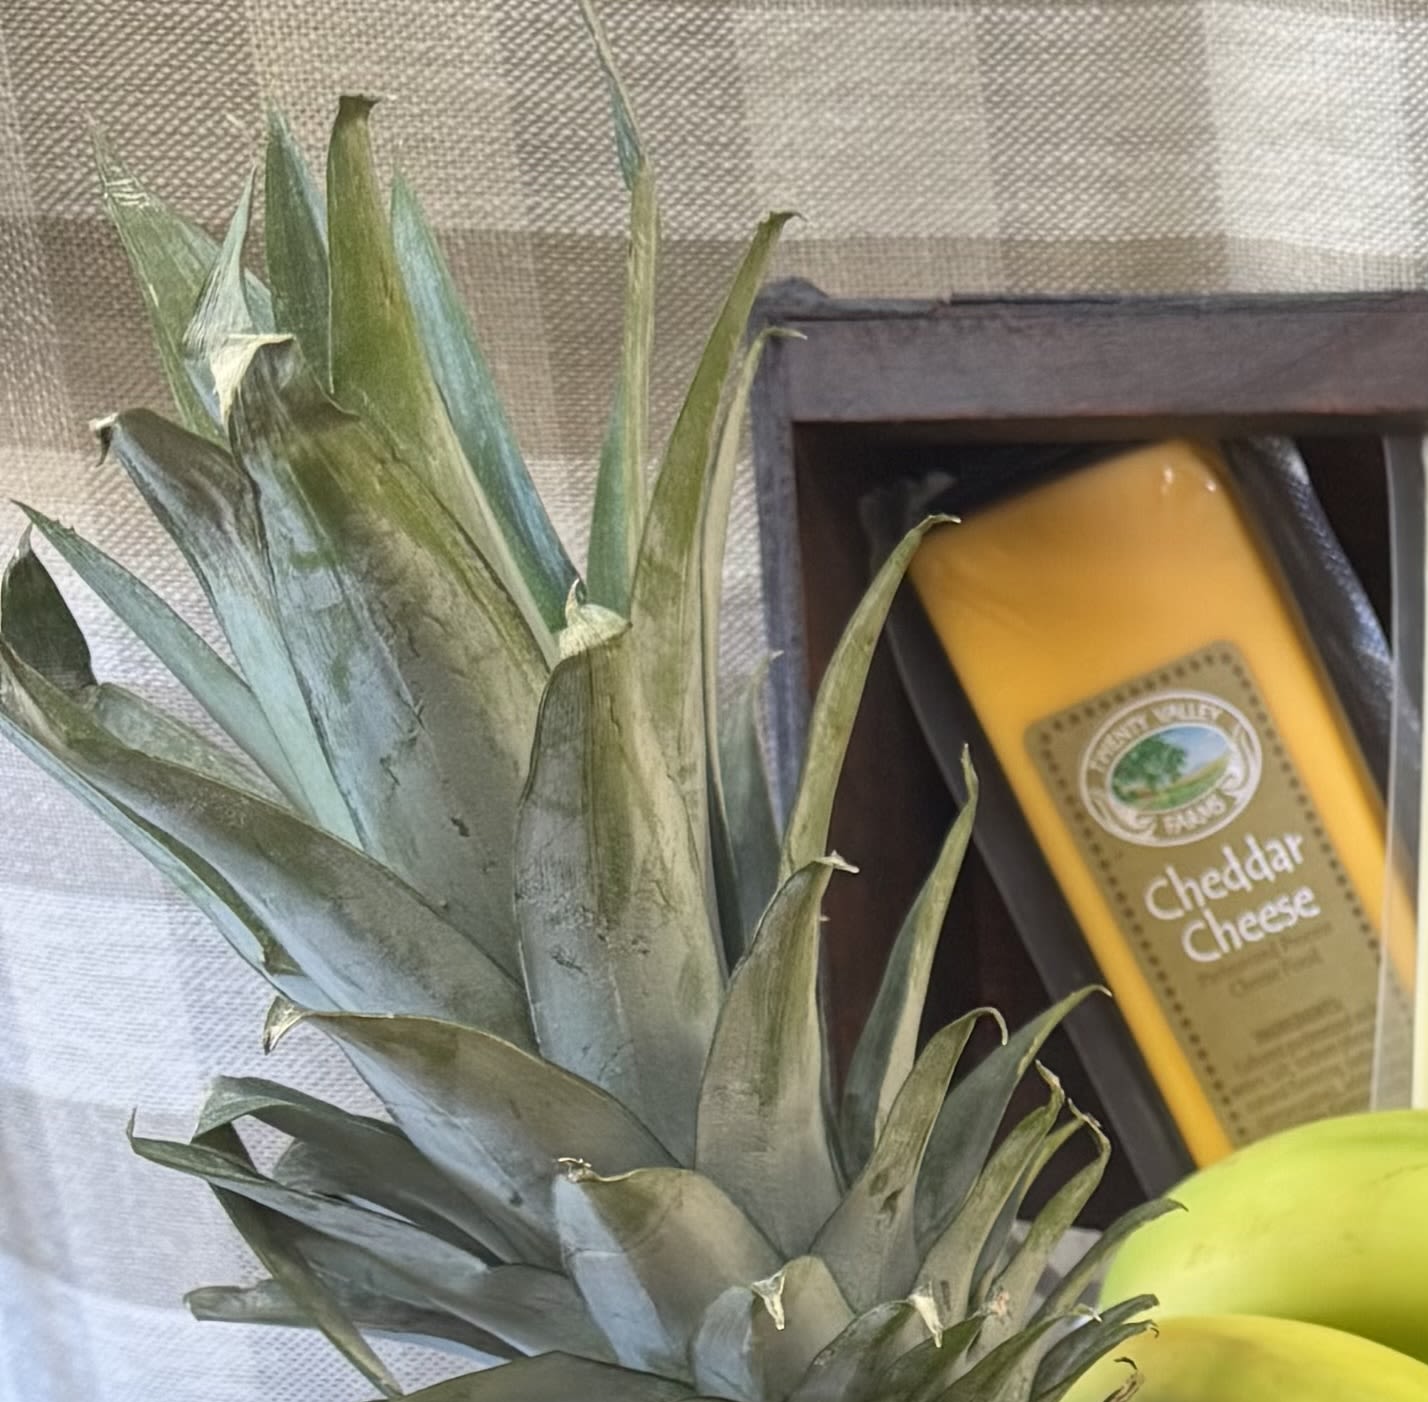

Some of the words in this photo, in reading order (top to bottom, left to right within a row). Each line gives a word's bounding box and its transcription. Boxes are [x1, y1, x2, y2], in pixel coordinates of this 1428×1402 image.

[1163, 794, 1228, 835] FARMS
[1144, 833, 1305, 920] Cheddar
[1181, 885, 1321, 963] Cheese
